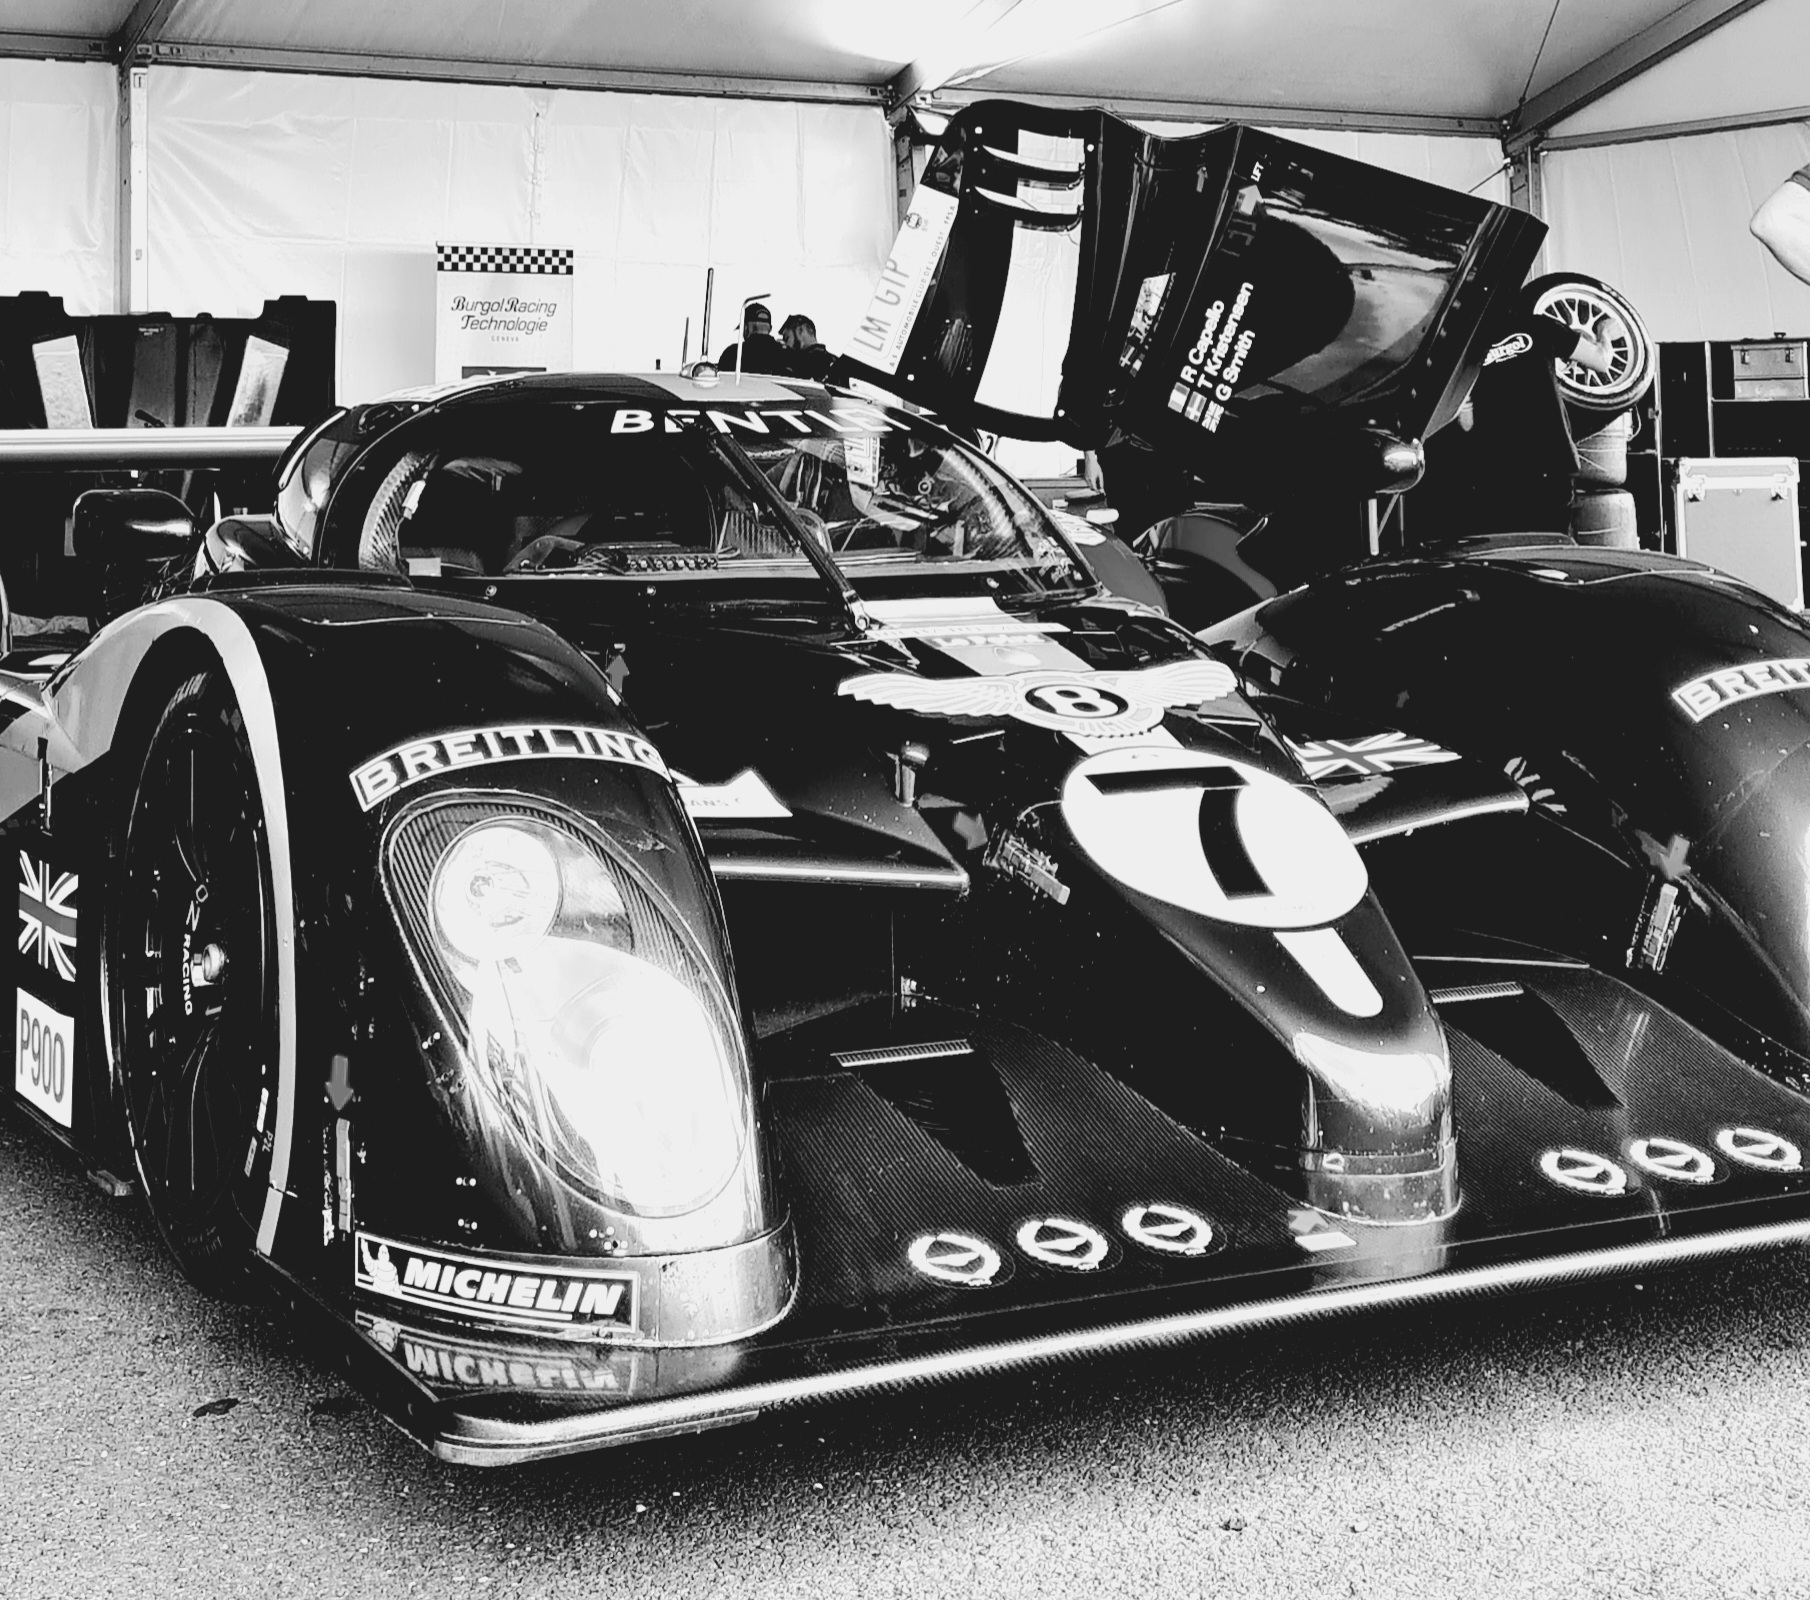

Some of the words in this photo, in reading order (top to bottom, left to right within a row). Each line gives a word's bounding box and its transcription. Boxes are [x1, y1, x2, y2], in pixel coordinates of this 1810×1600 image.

[451, 296, 505, 316] Burgol
[505, 297, 557, 317] Racing
[461, 315, 548, 335] Technologie
[895, 299, 919, 350] AUTOMOBILE
[1188, 300, 1225, 365] Capello
[1204, 282, 1254, 377] Kristensen
[853, 315, 891, 352] LM
[1222, 330, 1256, 384] Smith
[1180, 365, 1198, 384] R
[1197, 373, 1213, 388] T
[1215, 383, 1232, 401] G
[610, 409, 911, 434] BENTLEY
[356, 729, 662, 805] BREITLING
[1084, 766, 1276, 901] 7
[182, 933, 193, 1016] RACING
[20, 1008, 65, 1103] P900
[403, 1257, 624, 1316] MICHELIN
